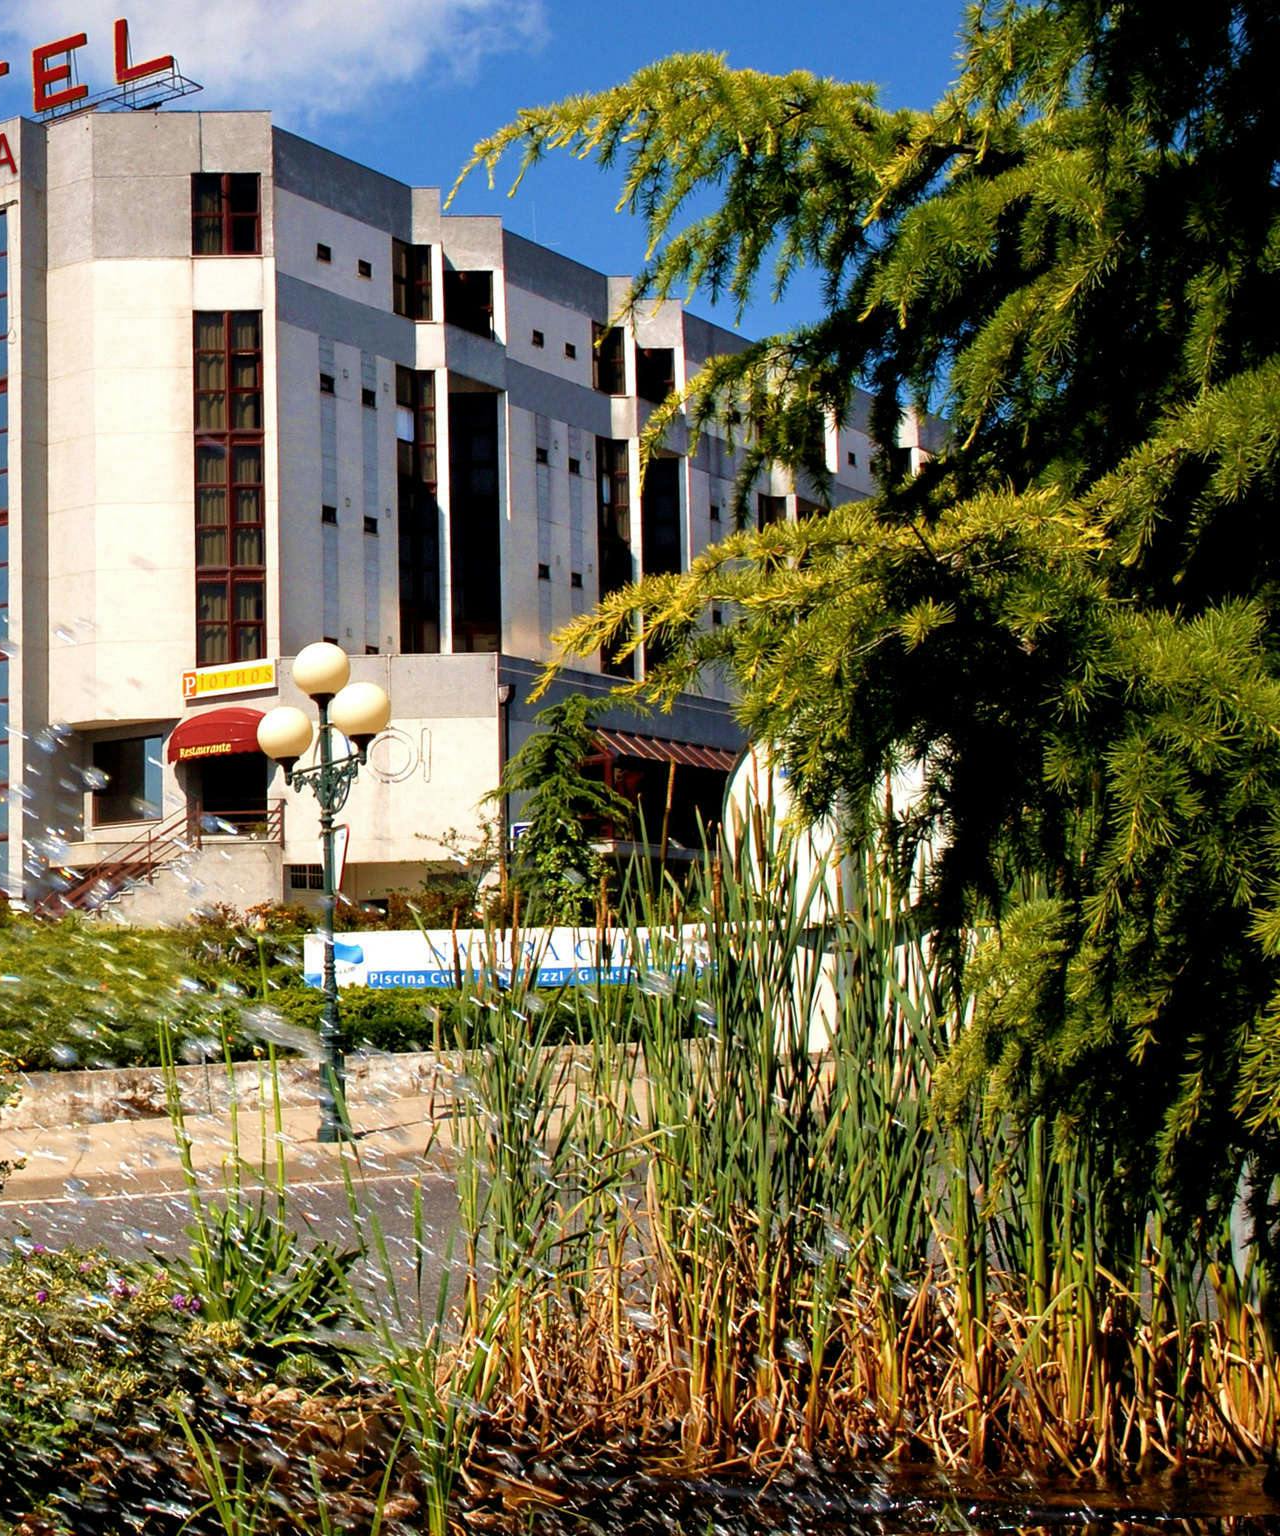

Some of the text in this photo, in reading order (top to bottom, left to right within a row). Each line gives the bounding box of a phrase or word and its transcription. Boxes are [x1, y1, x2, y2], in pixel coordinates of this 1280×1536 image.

[183, 667, 273, 697] Piornos
[179, 742, 232, 758] Restaurante
[428, 940, 560, 964] NARA
[369, 972, 426, 985] Piscina
